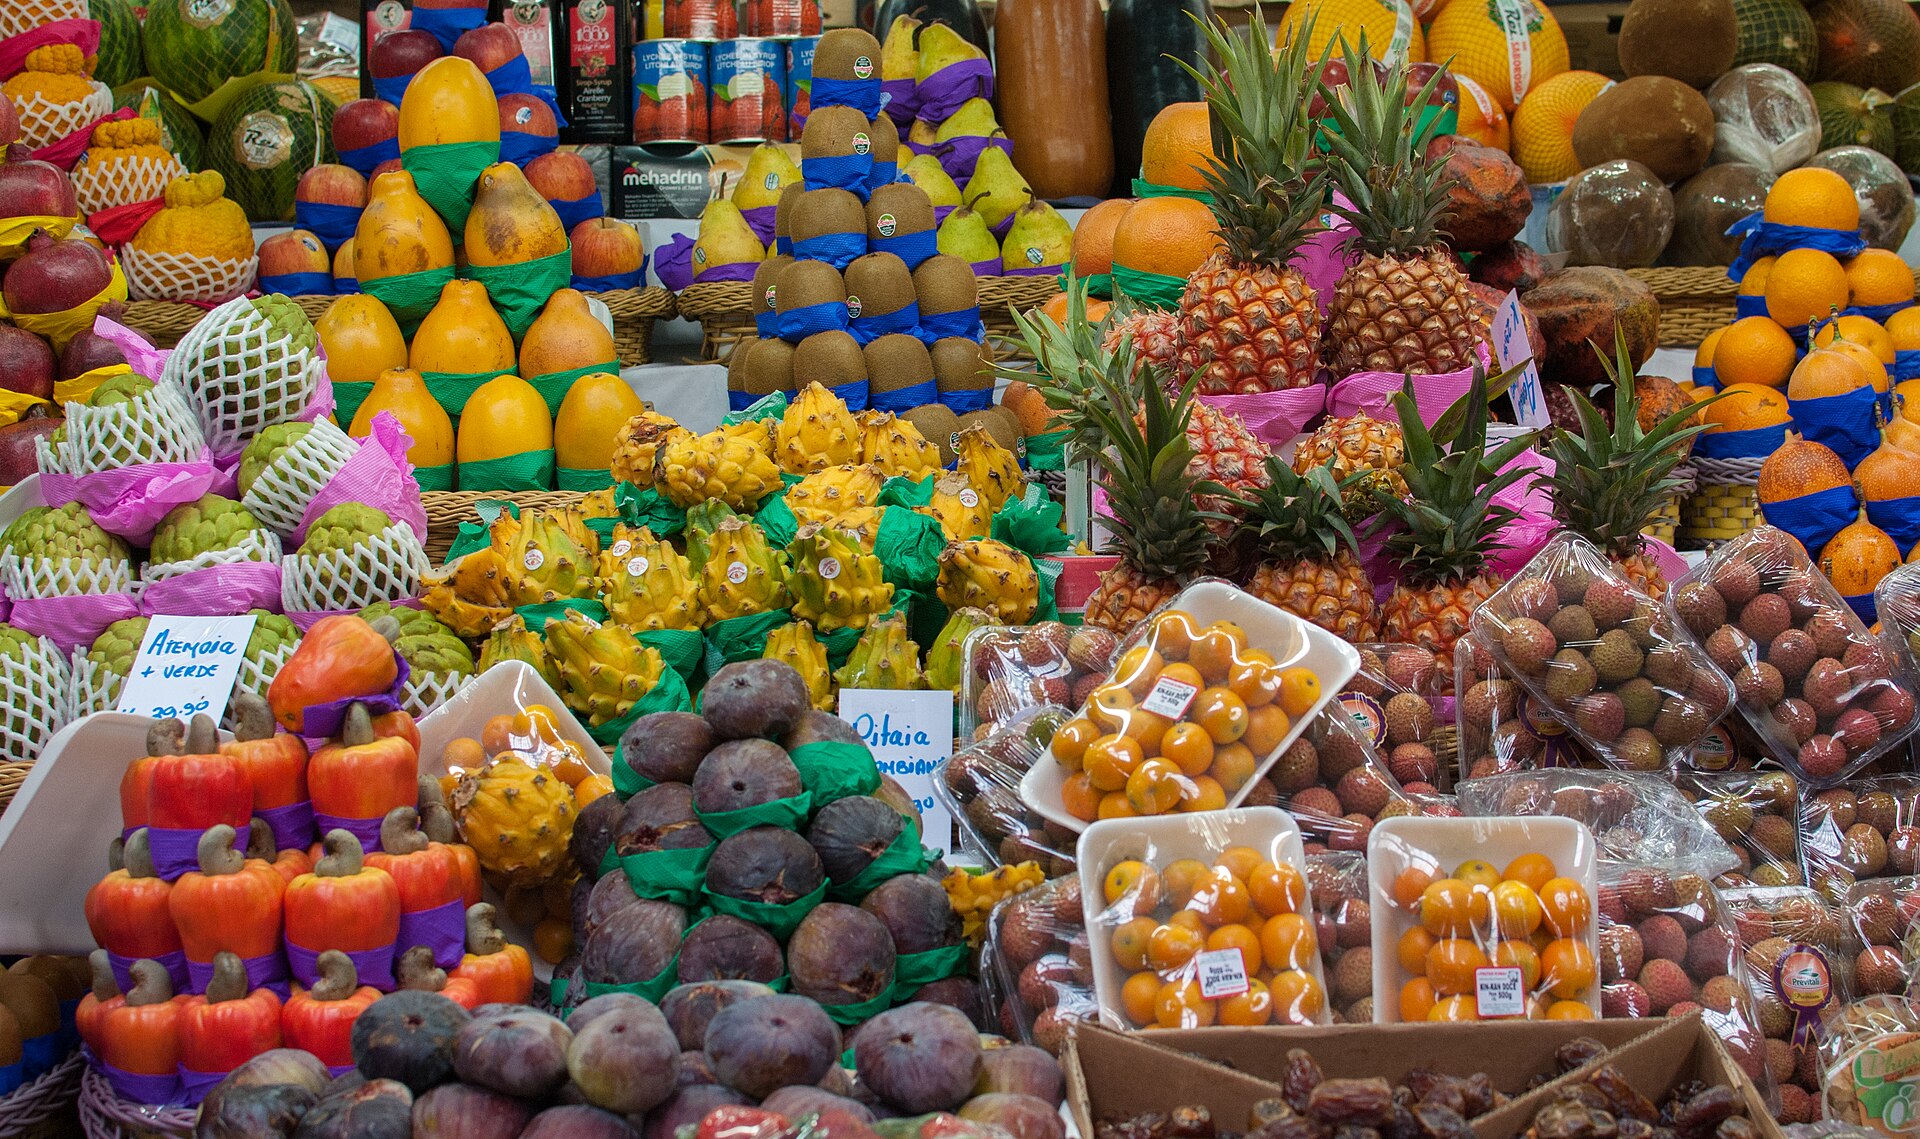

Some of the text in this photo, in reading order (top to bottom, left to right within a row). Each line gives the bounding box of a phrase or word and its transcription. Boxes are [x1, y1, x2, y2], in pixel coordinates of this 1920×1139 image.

[576, 25, 609, 41] 1883
[577, 95, 612, 103] Cranberry
[623, 169, 702, 186] mehadrin
[164, 665, 219, 678] VERDE
[1792, 978, 1820, 986] Previtali
